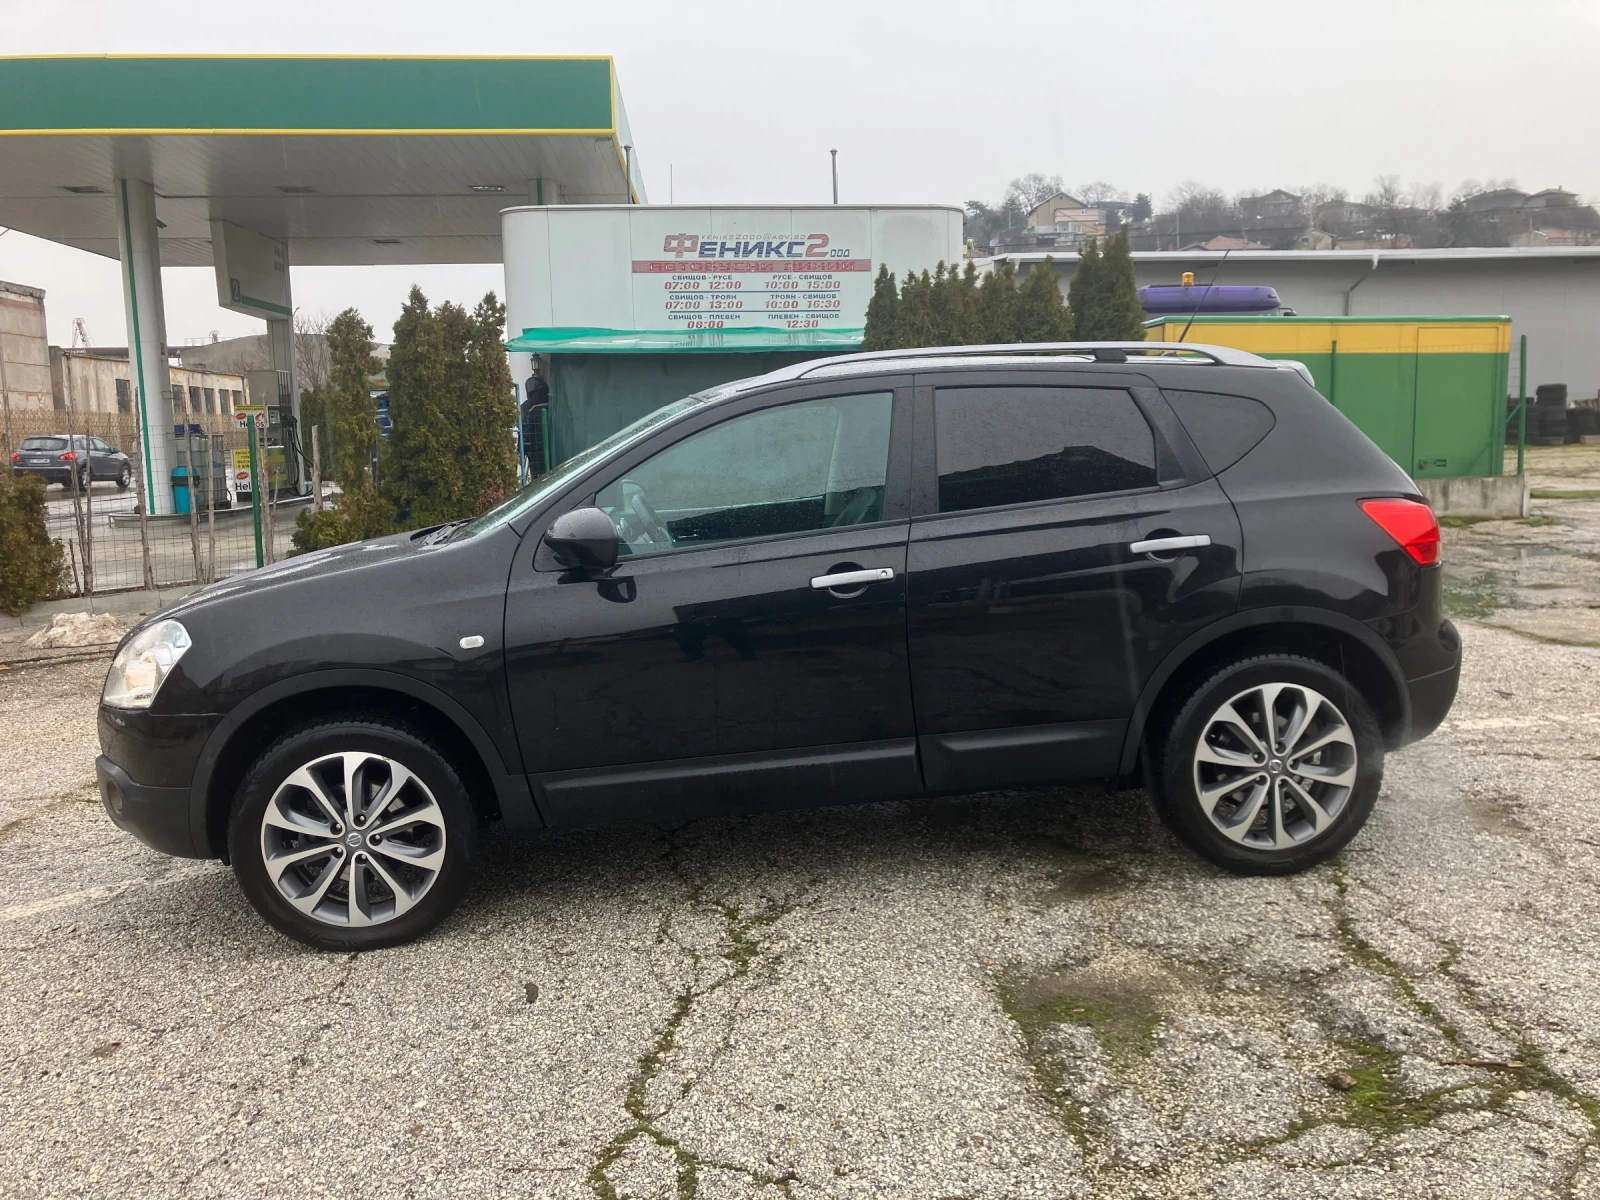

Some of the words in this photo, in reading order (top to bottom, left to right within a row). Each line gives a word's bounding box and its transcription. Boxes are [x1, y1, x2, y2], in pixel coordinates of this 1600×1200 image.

[664, 281, 700, 290] 07:00
[708, 281, 742, 290] 12:00
[765, 281, 799, 289] 10:00
[807, 280, 841, 289] 15:00
[232, 280, 240, 301] 2
[665, 301, 700, 310] 07:00
[709, 300, 743, 309] 13:00
[765, 300, 799, 309] 10:00
[807, 300, 840, 308] 16:30
[687, 320, 724, 329] 08:00
[786, 320, 819, 328] 12:30
